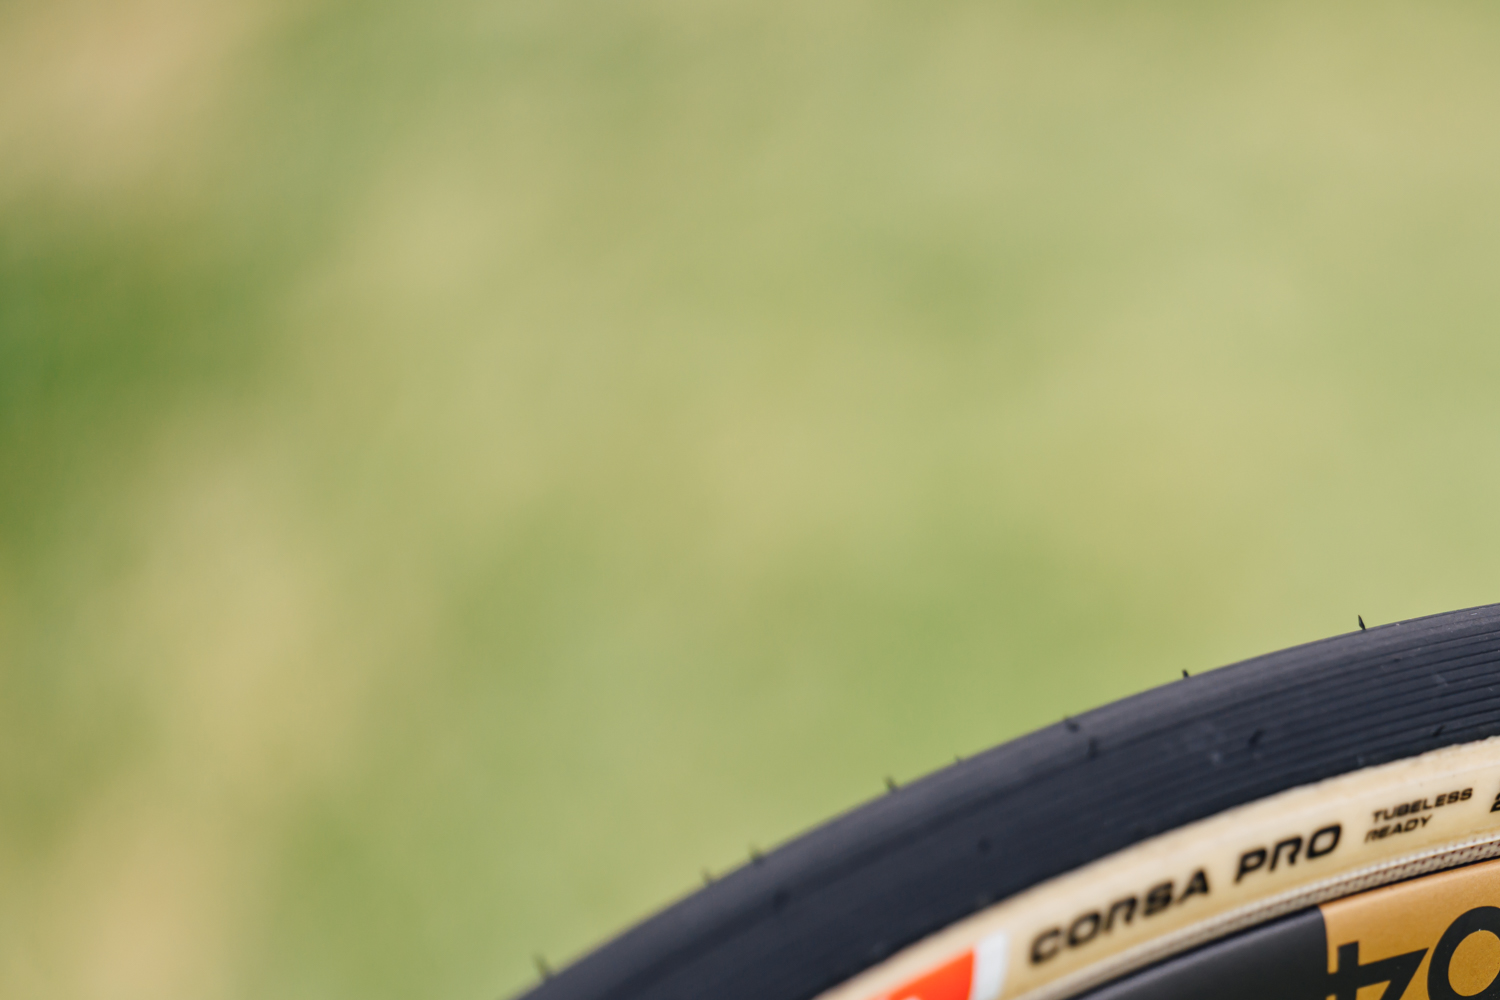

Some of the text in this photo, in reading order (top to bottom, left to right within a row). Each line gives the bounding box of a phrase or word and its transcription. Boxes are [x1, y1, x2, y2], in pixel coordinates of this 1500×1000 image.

[1372, 787, 1474, 823] TUBELESS
[1365, 814, 1434, 843] READY
[1027, 823, 1342, 967] CORSA PRO
